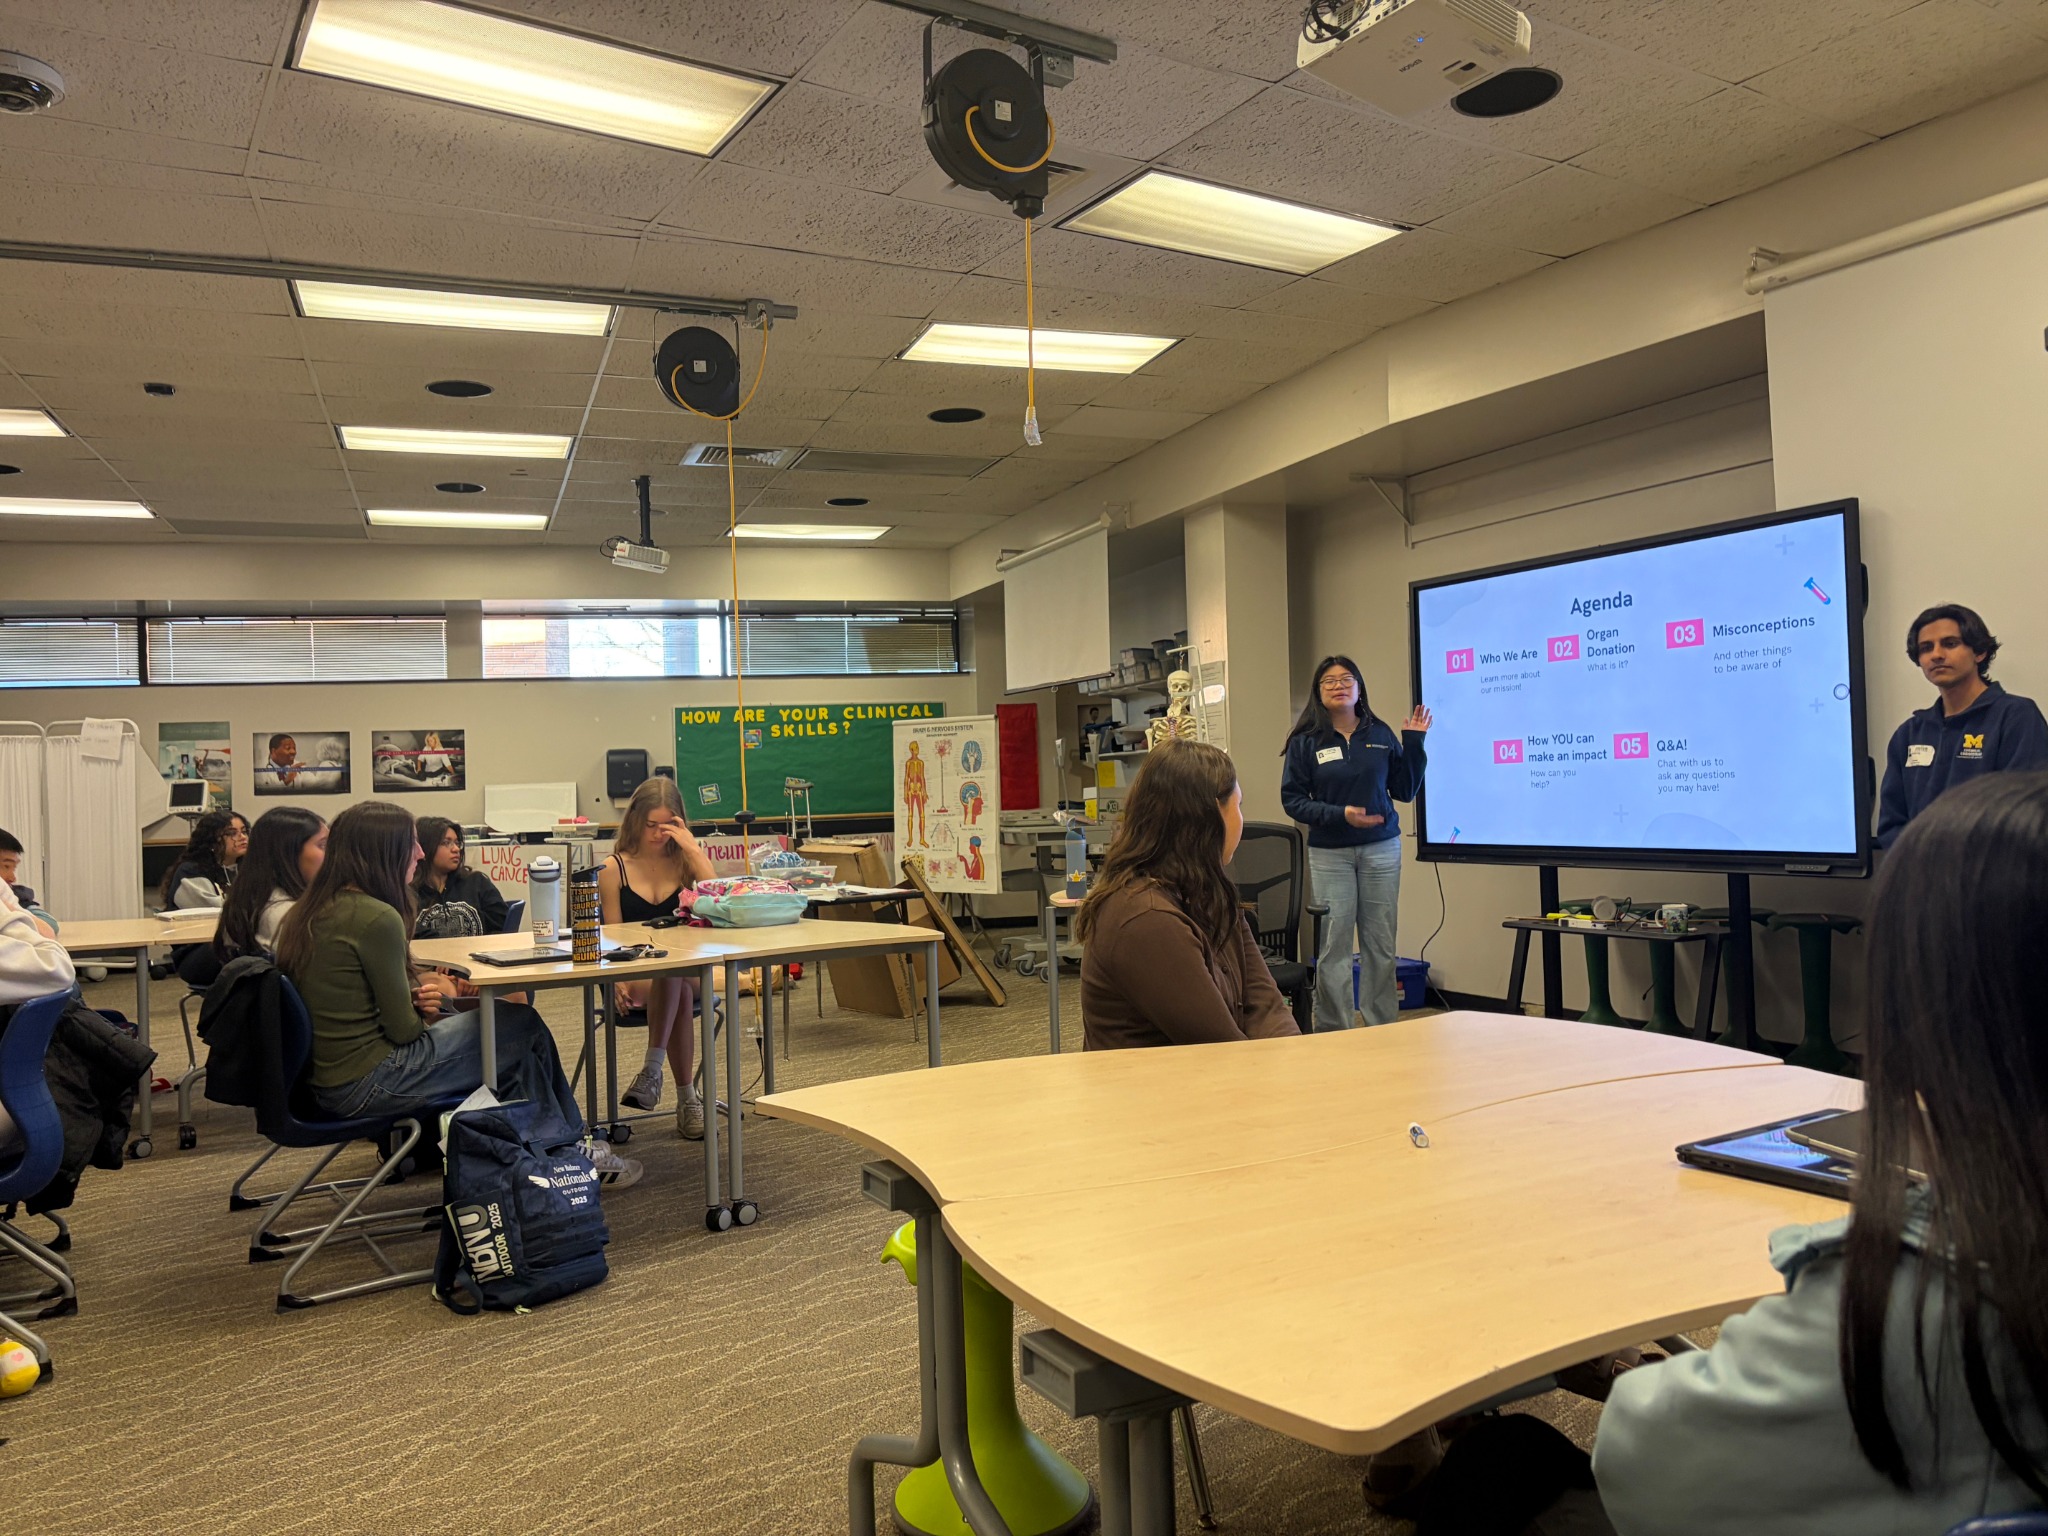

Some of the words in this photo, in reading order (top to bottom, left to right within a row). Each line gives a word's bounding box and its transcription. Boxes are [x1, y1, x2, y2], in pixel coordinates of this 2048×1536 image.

[1570, 591, 1633, 617] Agenda
[1587, 628, 1619, 641] Organ
[1673, 624, 1696, 644] 03
[1713, 616, 1815, 637] Misconceptions
[1554, 640, 1573, 657] 02
[1587, 642, 1635, 658] Donation
[1713, 651, 1731, 661] And
[1734, 648, 1758, 660] other
[1762, 645, 1792, 657] things
[1452, 653, 1467, 669] 01
[1480, 651, 1501, 665] Who
[1503, 650, 1518, 661] We
[1521, 649, 1538, 660] Are
[1587, 662, 1607, 672] What
[1610, 661, 1616, 670] is
[1618, 660, 1629, 670] it?
[1714, 665, 1723, 674] to
[1726, 662, 1738, 672] be
[1741, 661, 1769, 672] aware
[1772, 658, 1782, 669] of
[1480, 675, 1499, 684] Learn
[1501, 673, 1519, 682] more
[1521, 670, 1540, 680] about
[1481, 686, 1492, 694] our
[1494, 683, 1522, 694] mission!
[681, 710, 721, 725] HOW
[733, 709, 765, 722] ARE
[779, 707, 829, 722] YOUR
[843, 704, 934, 720] CLINICAL
[770, 721, 851, 738] SKILLS?
[1528, 735, 1549, 746] How
[1551, 733, 1573, 745] YOU
[1576, 734, 1595, 744] can
[1620, 737, 1642, 755] 05
[1656, 739, 1687, 752] Q&A!
[1963, 734, 1984, 748] M
[1499, 744, 1517, 760] 04
[1528, 751, 1554, 762] make
[1557, 752, 1569, 761] an
[1572, 749, 1607, 763] impact
[1657, 759, 1677, 768] Chat
[1679, 758, 1698, 767] with
[1701, 759, 1711, 767] us
[1714, 758, 1724, 767] to
[1530, 769, 1546, 778] How
[1548, 769, 1561, 777] can
[1563, 769, 1577, 779] you
[1657, 771, 1672, 781] ask
[1674, 771, 1689, 782] any
[1692, 769, 1736, 782] questions
[1531, 780, 1550, 790] help?
[1658, 784, 1673, 795] you
[1676, 783, 1694, 795] may
[1696, 783, 1720, 793] have!
[481, 845, 522, 867] LUNG
[553, 1166, 565, 1174] New
[549, 1171, 591, 1189] Nationals
[562, 1186, 588, 1195] OUTDOOR
[570, 1195, 588, 1206] 2025
[487, 1202, 503, 1229] 2025
[494, 1234, 515, 1278] OUTDOOR
